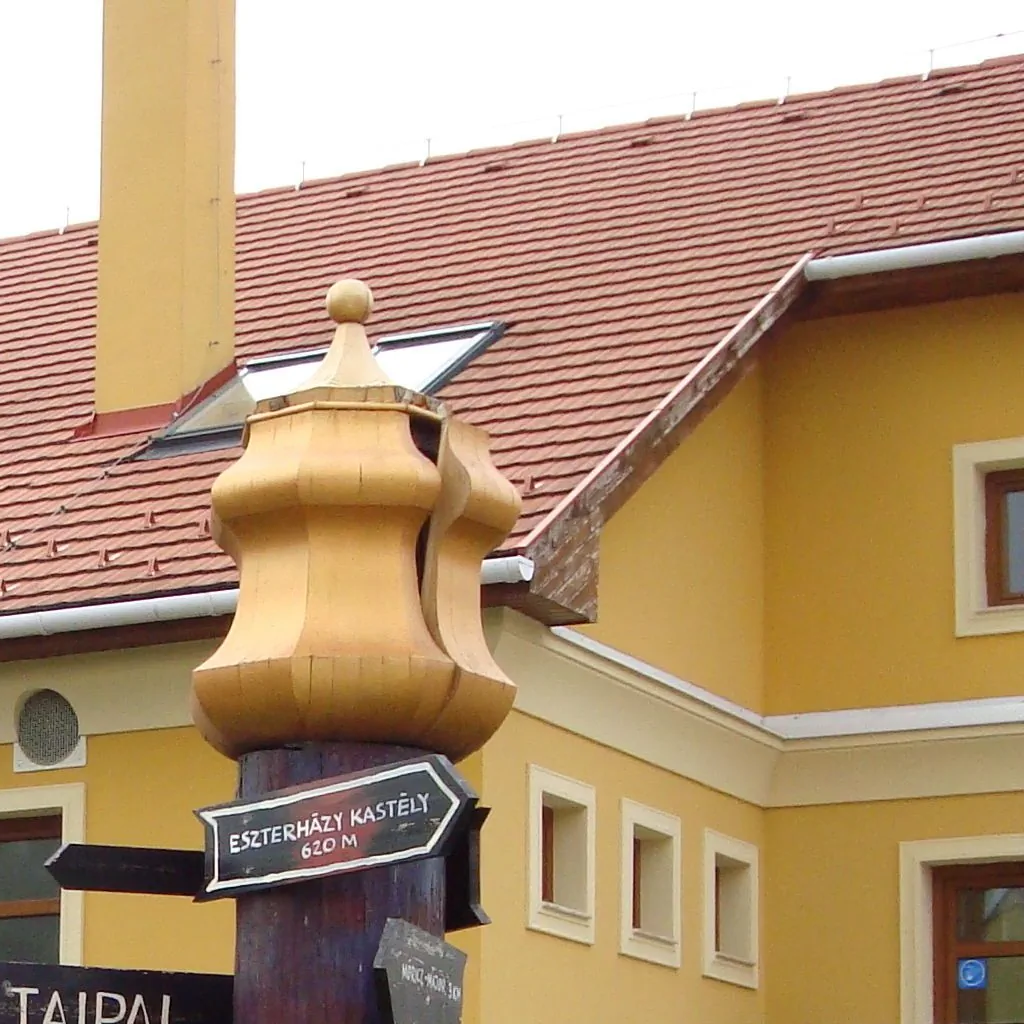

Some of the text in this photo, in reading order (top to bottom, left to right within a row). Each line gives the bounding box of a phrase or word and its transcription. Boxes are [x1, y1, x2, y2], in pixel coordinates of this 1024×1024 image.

[230, 791, 429, 854] ESZTERHÁZY KASTÉLY
[301, 833, 358, 859] 620 M
